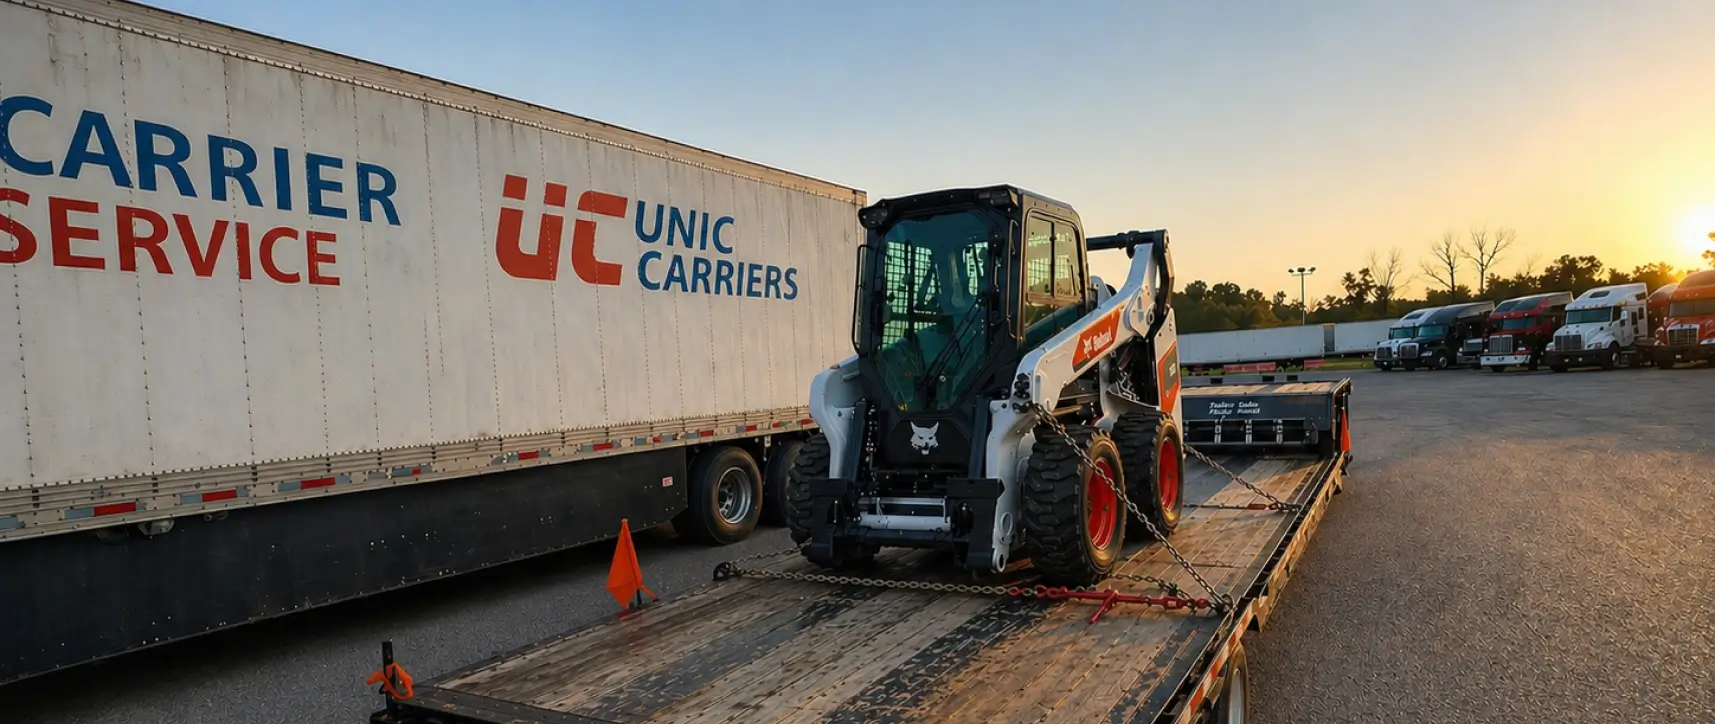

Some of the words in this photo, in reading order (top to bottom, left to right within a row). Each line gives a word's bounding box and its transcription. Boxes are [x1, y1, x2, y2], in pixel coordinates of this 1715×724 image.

[0, 95, 401, 226] CARRIER
[0, 186, 341, 287] SERVICE
[635, 200, 735, 254] UNIC
[637, 250, 799, 301] CARRIERS
